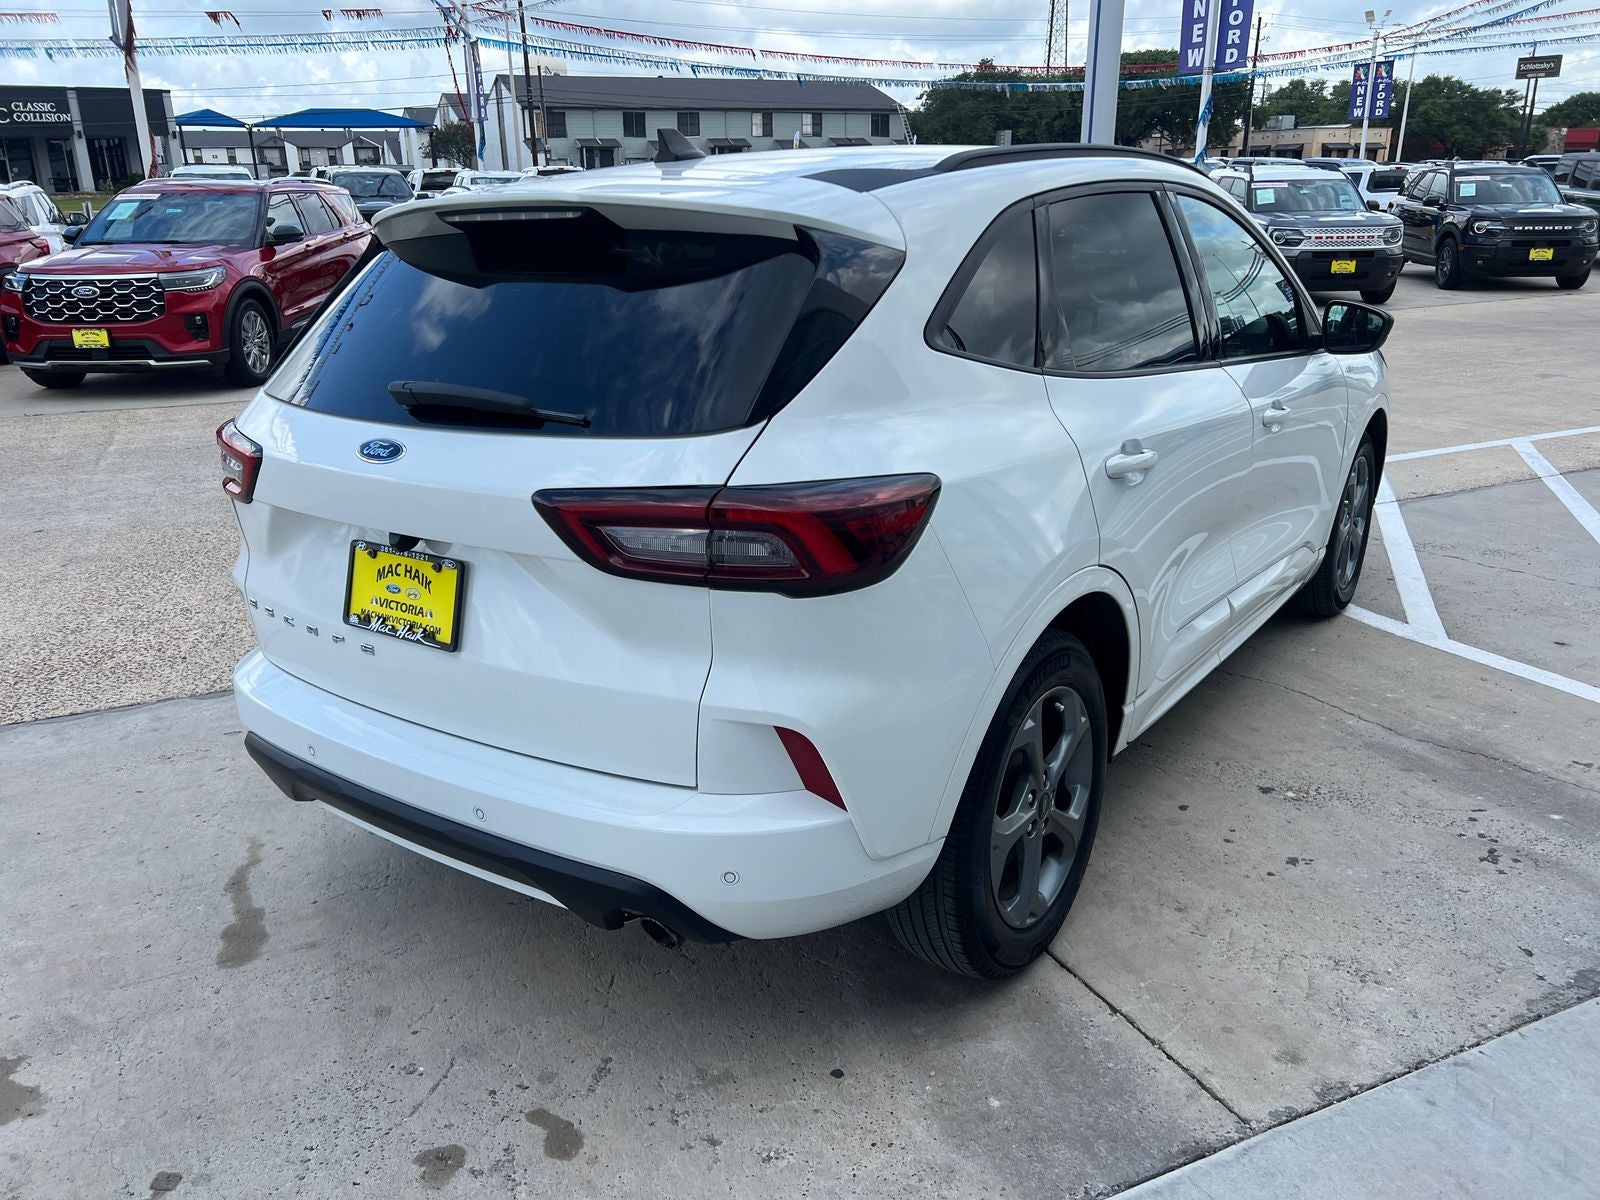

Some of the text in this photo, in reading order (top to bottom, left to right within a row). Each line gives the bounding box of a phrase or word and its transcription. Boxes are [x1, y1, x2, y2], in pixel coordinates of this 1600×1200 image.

[1187, 0, 1206, 68] NEW
[11, 101, 56, 112] CLASSIC
[1353, 85, 1365, 117] NEW
[1375, 83, 1386, 116] FORD
[13, 112, 71, 122] COLLISION
[376, 563, 432, 595] MAC HAIK
[379, 597, 424, 618] VICTORIA
